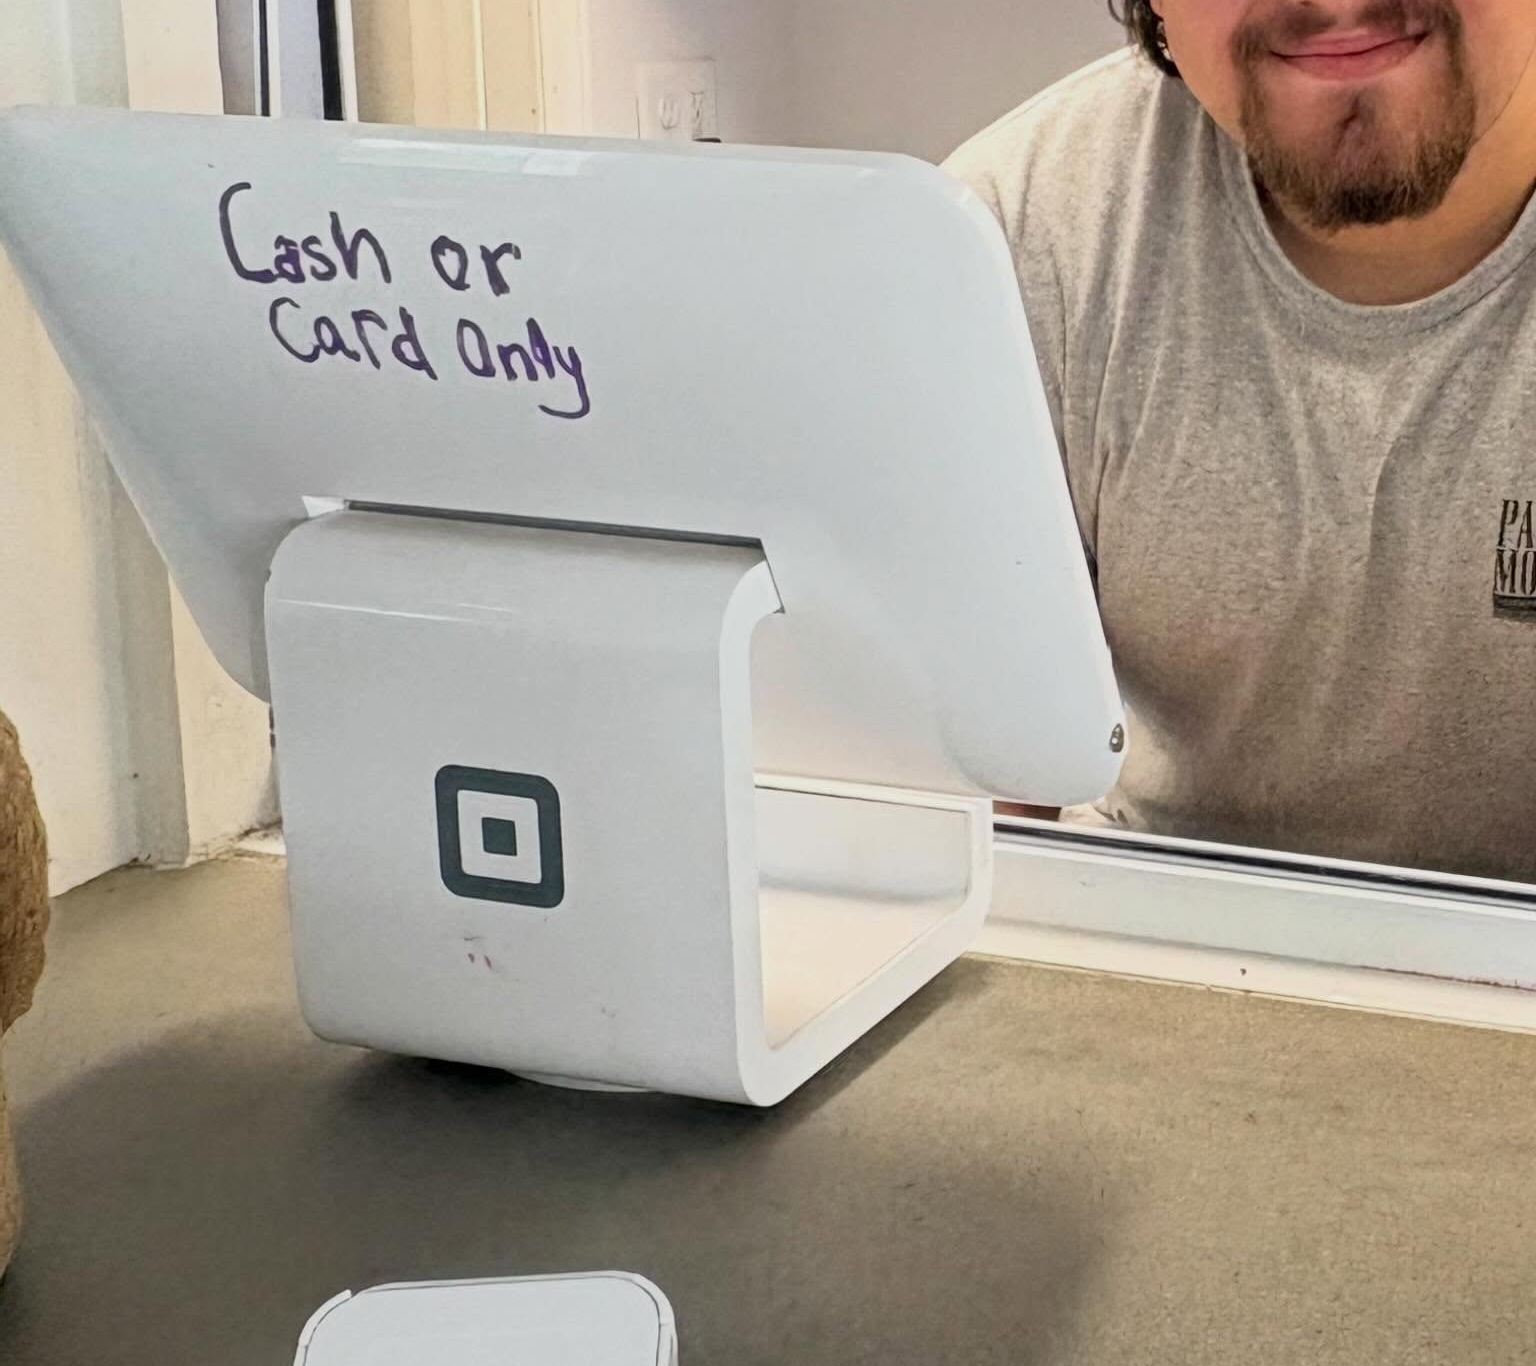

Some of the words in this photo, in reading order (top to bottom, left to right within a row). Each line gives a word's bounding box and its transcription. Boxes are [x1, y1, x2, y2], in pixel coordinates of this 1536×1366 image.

[219, 182, 391, 284] Cash
[431, 235, 522, 296] or
[269, 297, 438, 381] Card
[457, 318, 590, 419] Only
